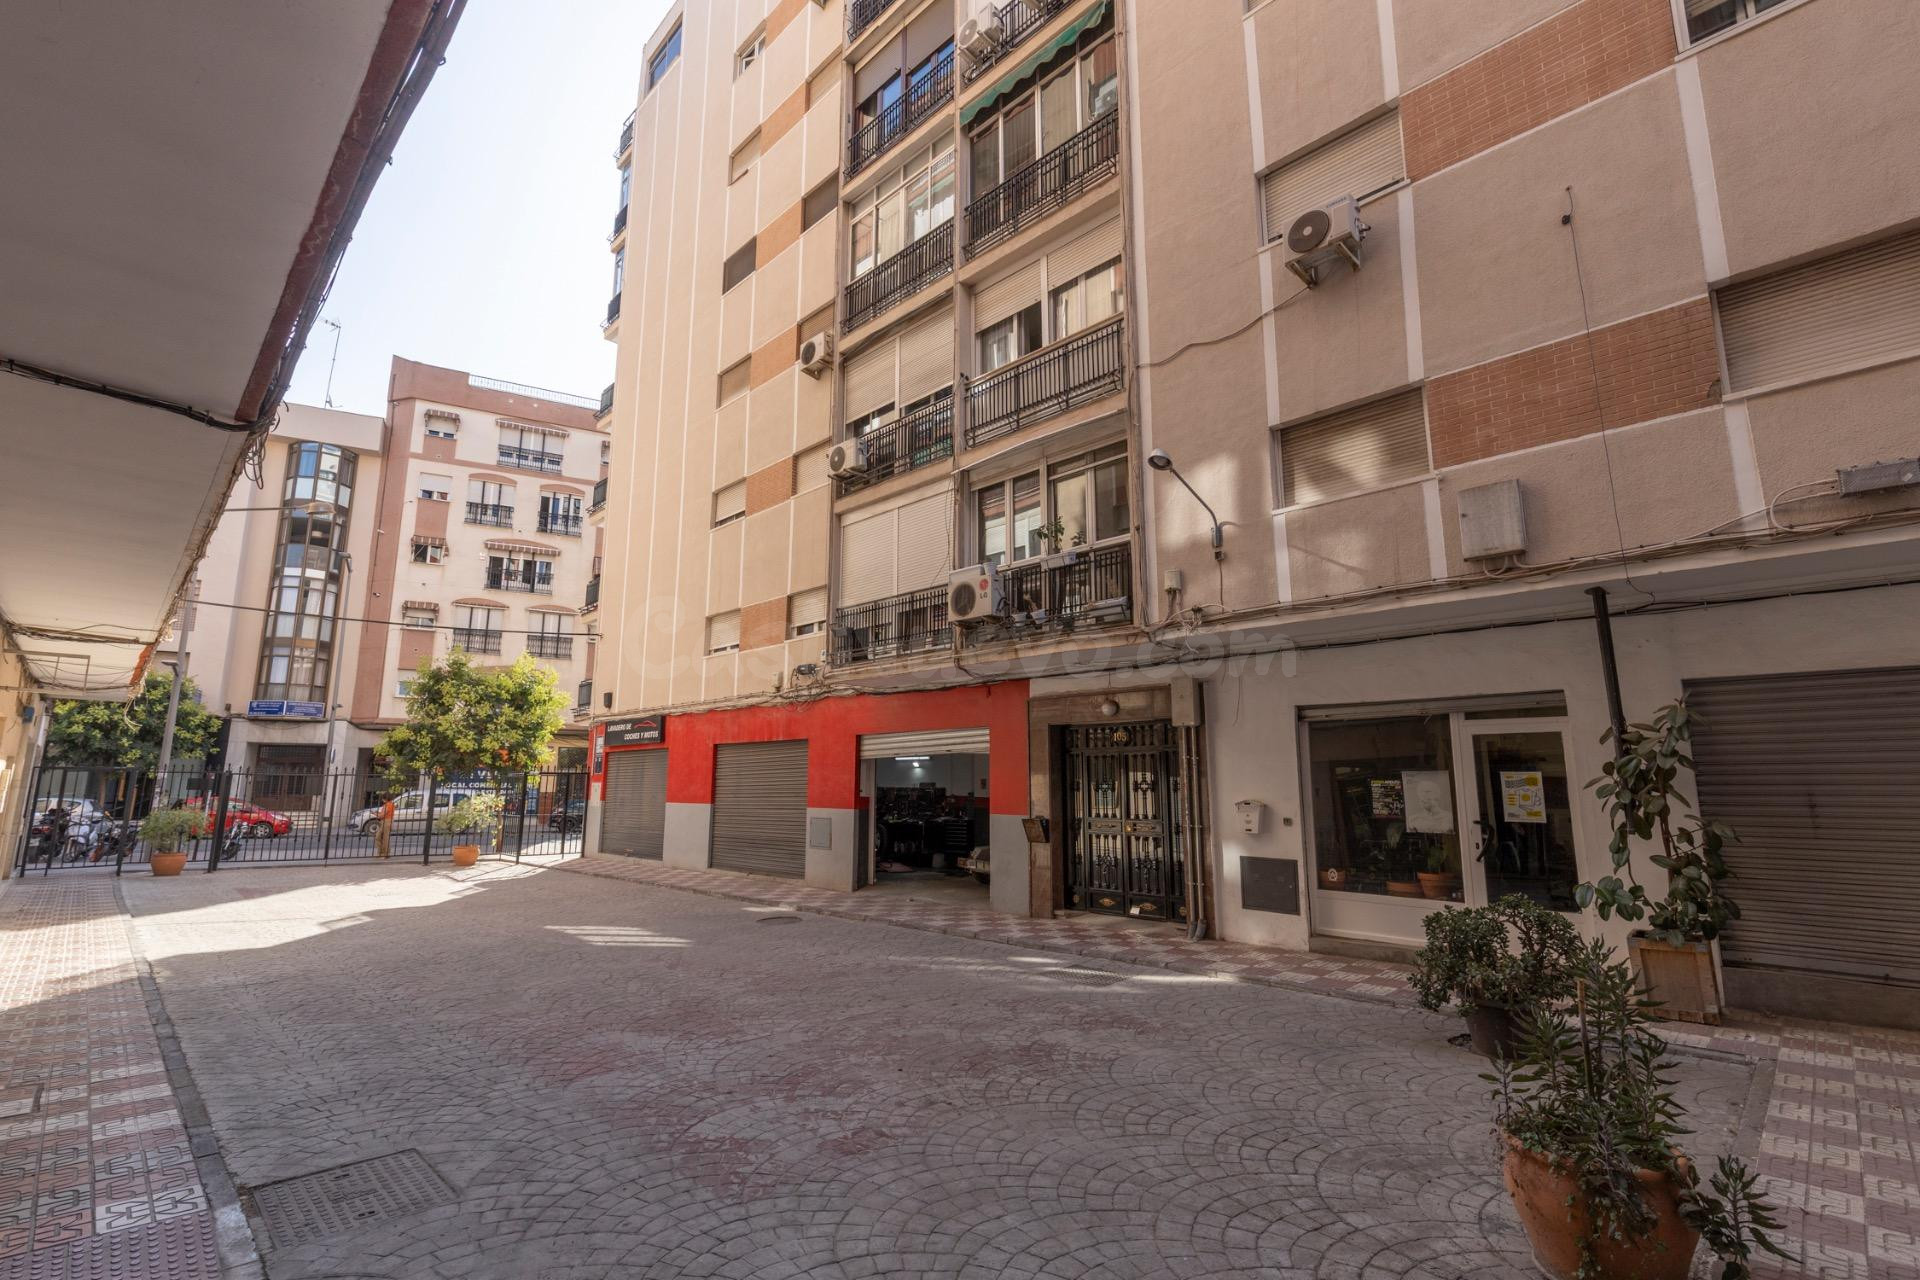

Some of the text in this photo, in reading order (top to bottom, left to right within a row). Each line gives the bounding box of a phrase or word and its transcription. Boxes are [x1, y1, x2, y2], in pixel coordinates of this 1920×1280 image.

[979, 591, 988, 600] LG
[607, 724, 626, 732] LAVADERO
[624, 732, 640, 740] COCHES
[644, 731, 659, 739] MOTOS
[1113, 731, 1127, 742] 105
